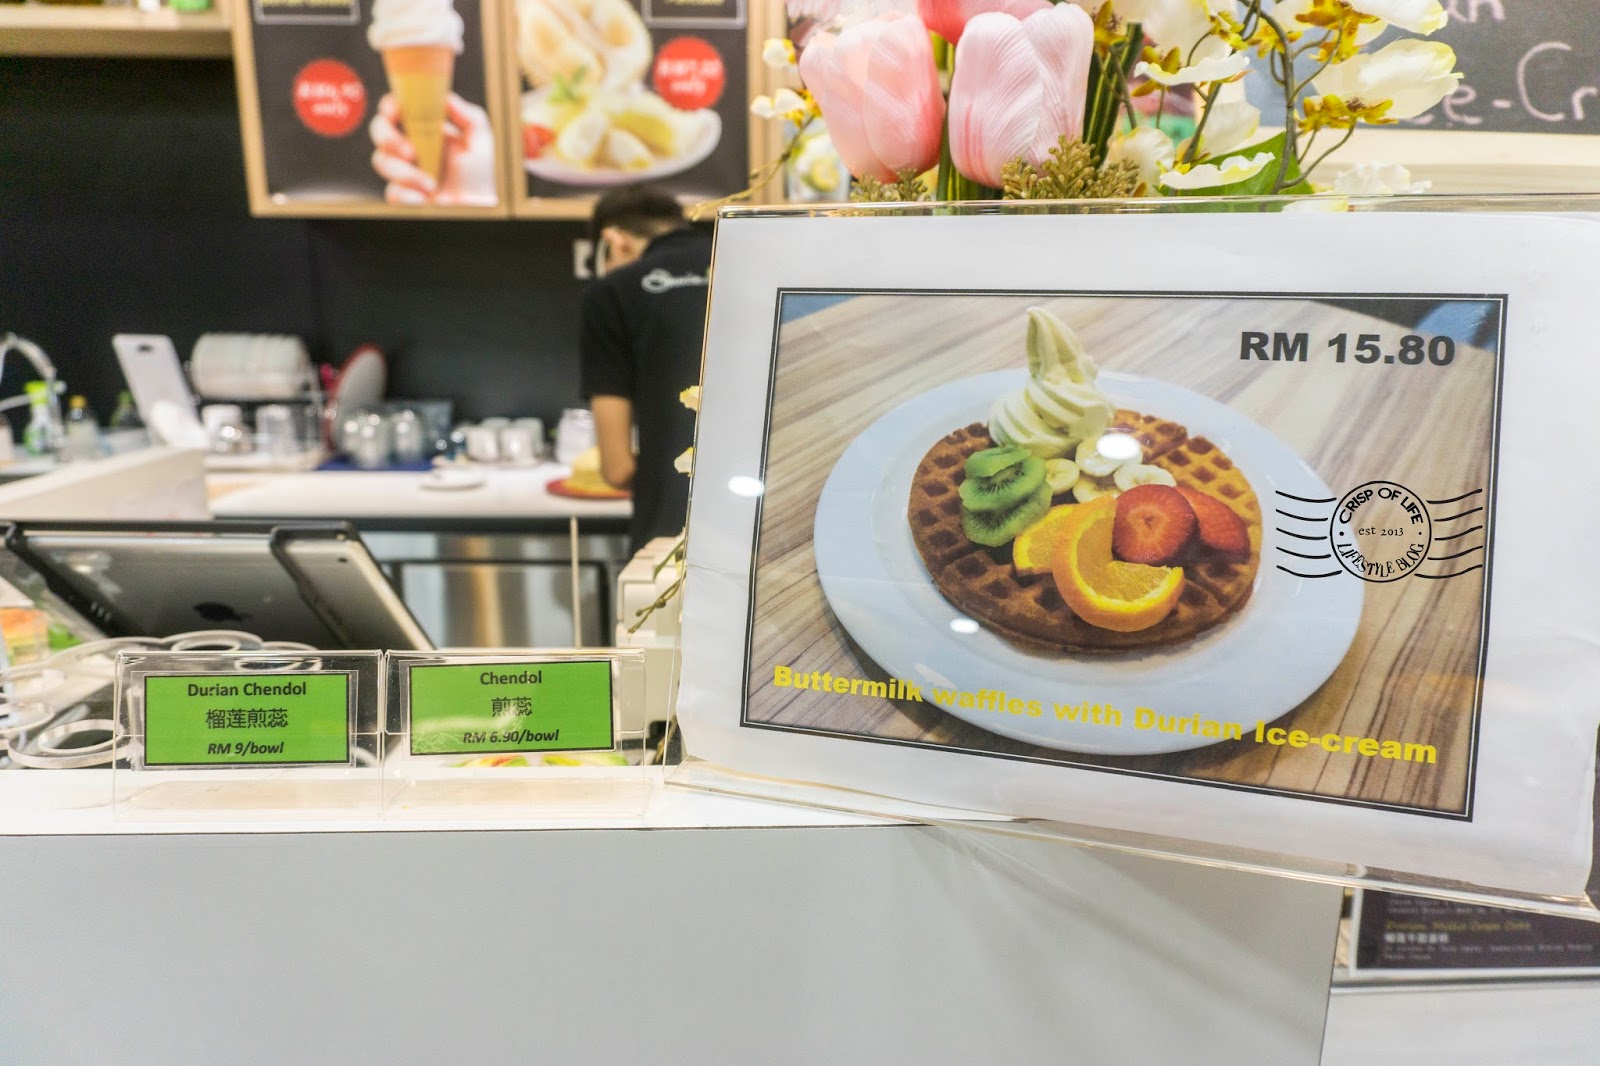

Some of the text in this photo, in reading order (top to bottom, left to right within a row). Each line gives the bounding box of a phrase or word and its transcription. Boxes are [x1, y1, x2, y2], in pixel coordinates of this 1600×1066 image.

[1240, 331, 1456, 366] RM 15.80
[479, 670, 542, 685] Chendol
[187, 681, 307, 697] Durian Chendol
[491, 697, 533, 718] 煎蕊
[773, 665, 1436, 764] Buttermilk waffles with Durian Ice-cream
[205, 707, 289, 730] 榴莲煎蕊
[463, 729, 560, 745] RM 6.90/bowl
[207, 741, 284, 757] RM 9/bowl
